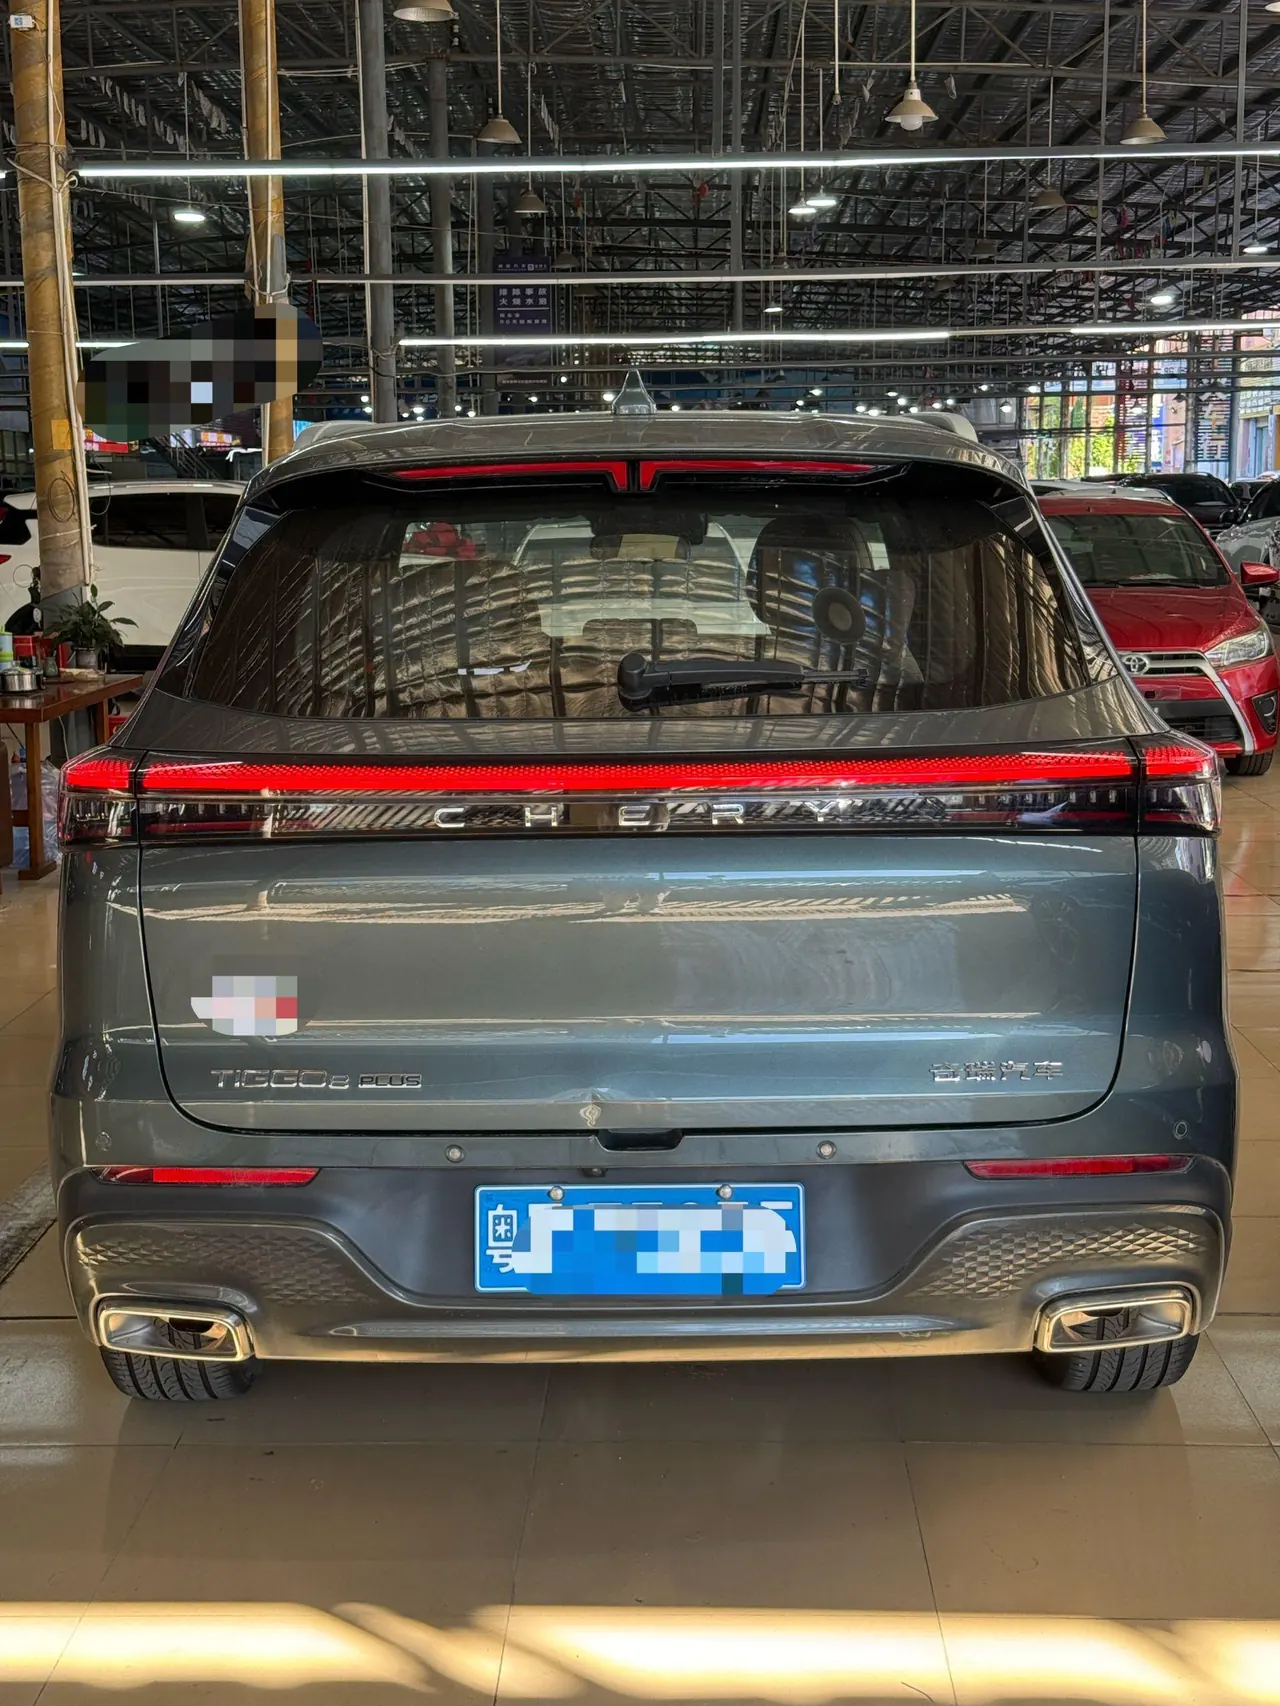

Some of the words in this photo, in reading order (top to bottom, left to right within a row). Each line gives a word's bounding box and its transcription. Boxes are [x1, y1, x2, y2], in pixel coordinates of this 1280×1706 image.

[434, 804, 835, 827] CHERY
[358, 1074, 422, 1088] PLUS
[929, 1060, 1064, 1082] 奇瑞汽车
